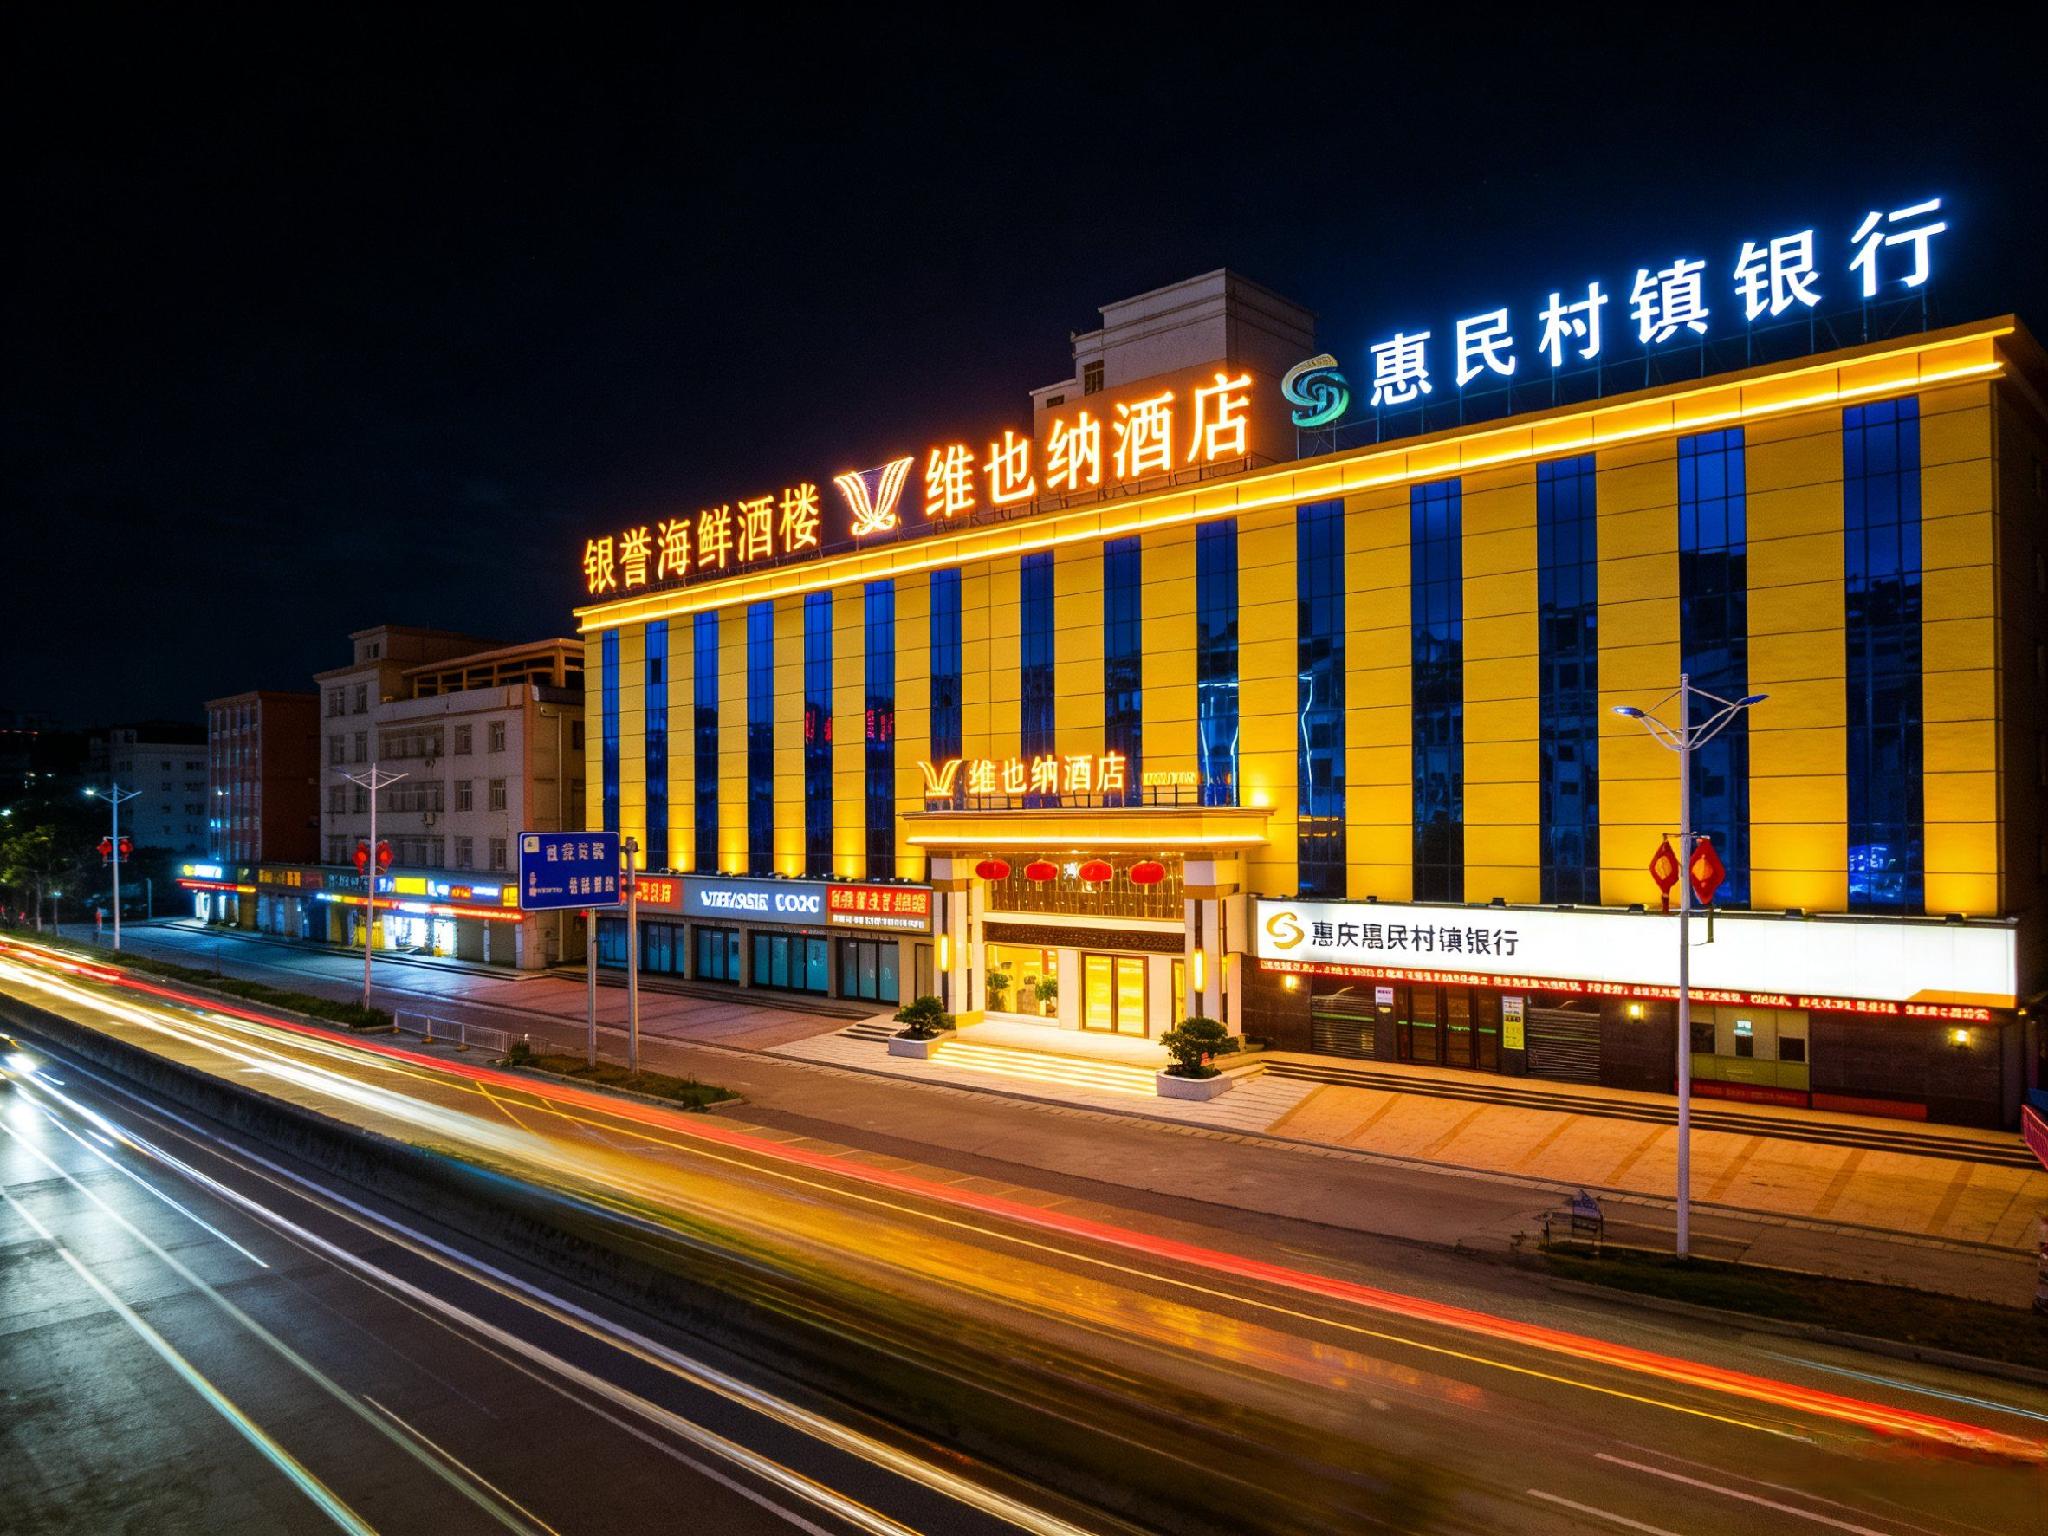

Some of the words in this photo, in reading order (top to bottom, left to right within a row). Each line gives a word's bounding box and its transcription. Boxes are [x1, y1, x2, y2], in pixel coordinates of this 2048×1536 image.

[1369, 197, 1949, 407] 惠民村镇银行
[924, 373, 1253, 518] 维也纳酒店
[584, 482, 821, 595] 银誉海鲜酒楼
[968, 750, 1127, 796] 维也纳酒店
